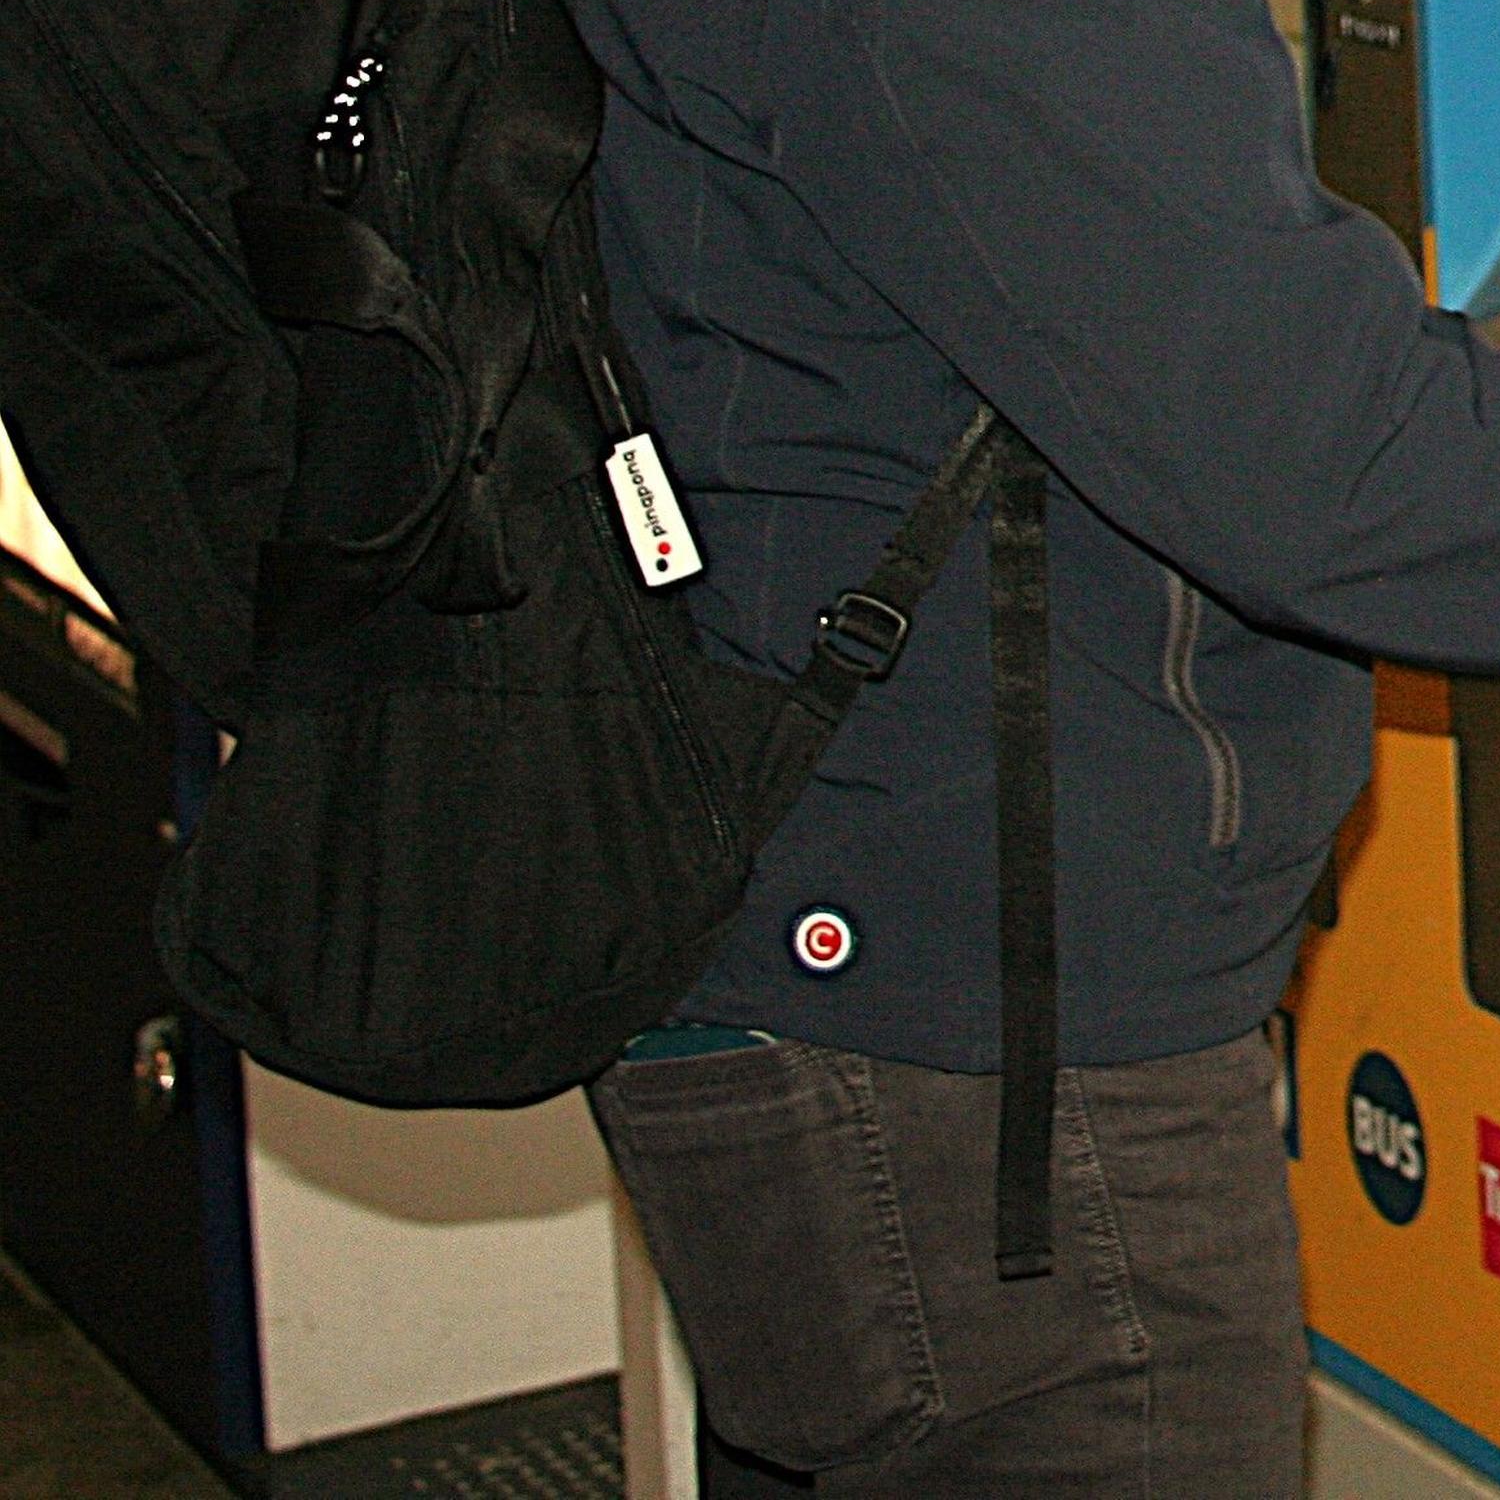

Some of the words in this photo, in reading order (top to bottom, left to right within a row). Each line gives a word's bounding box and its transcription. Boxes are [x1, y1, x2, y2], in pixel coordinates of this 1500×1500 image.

[622, 449, 667, 537] pingpong
[809, 926, 835, 955] C
[1353, 1093, 1422, 1182] BUS
